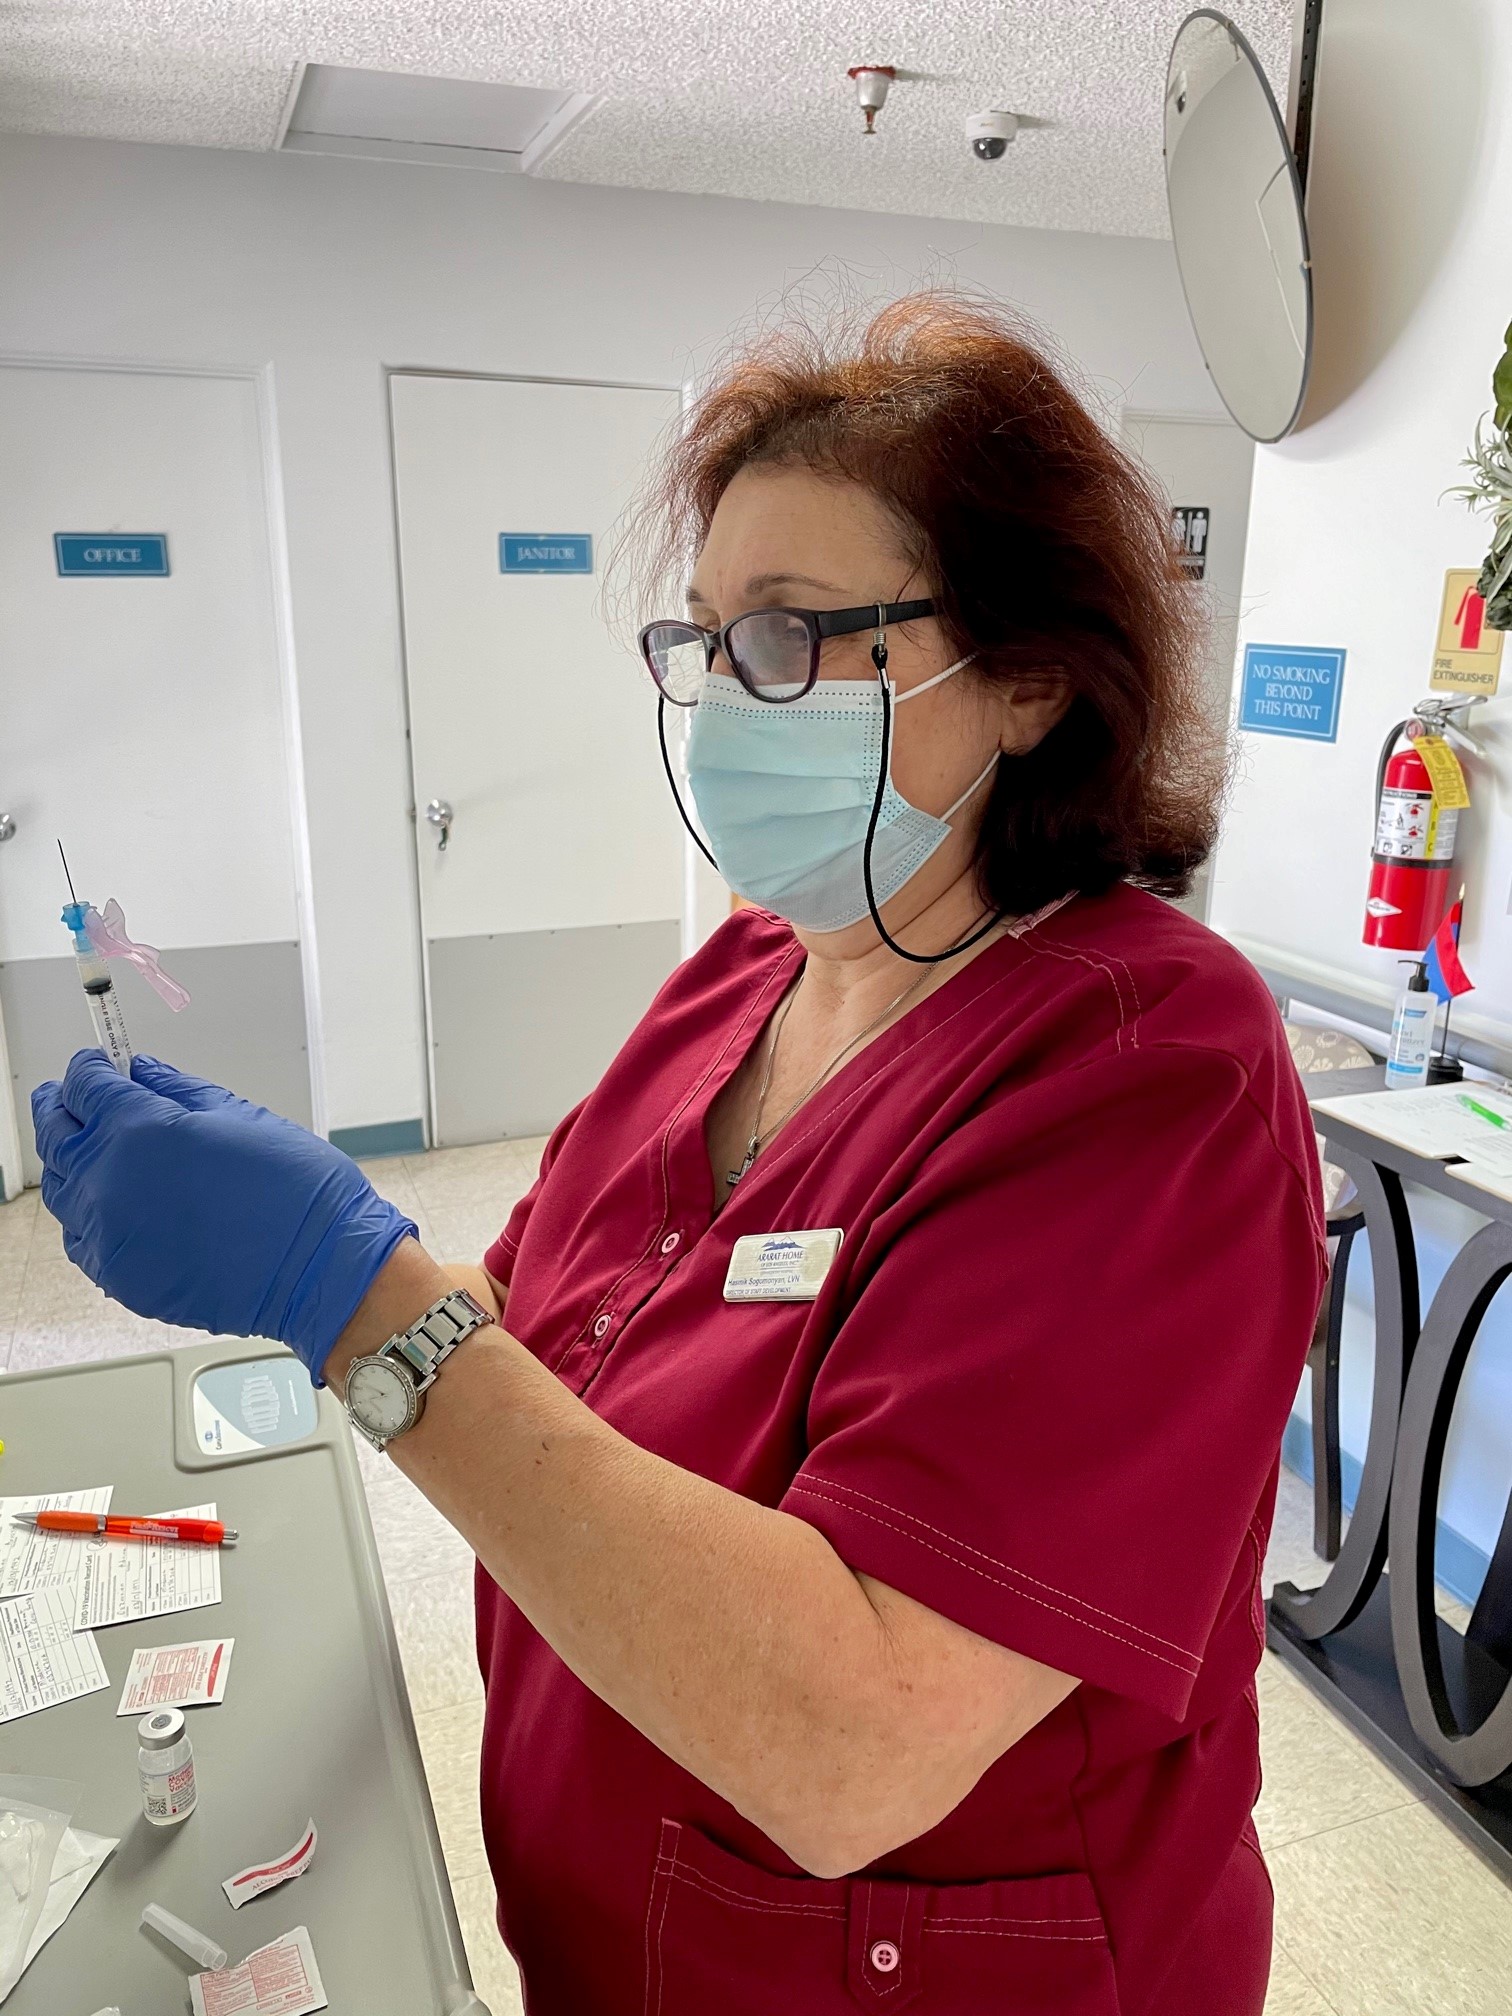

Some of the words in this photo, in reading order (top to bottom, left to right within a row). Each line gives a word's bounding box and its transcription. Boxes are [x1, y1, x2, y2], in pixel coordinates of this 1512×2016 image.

[83, 547, 142, 563] OFFICE
[517, 547, 575, 562] JANITOR
[1434, 658, 1453, 669] FIRE
[1252, 664, 1271, 679] NO
[1272, 665, 1330, 685] SMOKING
[1433, 670, 1494, 684] EXTINGUISHER
[1265, 683, 1313, 701] BEYOND
[1254, 699, 1281, 716] THIS
[1283, 702, 1321, 720] POINT
[99, 994, 109, 1016] INGLE
[104, 1017, 113, 1031] USE
[108, 1032, 118, 1050] ONLY
[757, 1252, 781, 1261] ARARAT
[781, 1250, 804, 1260] HOME
[787, 1275, 800, 1283] LVN
[85, 1554, 93, 1565] Card
[84, 1565, 92, 1580] Record
[82, 1580, 91, 1604] Vaccination
[80, 1604, 88, 1625] COVID-19
